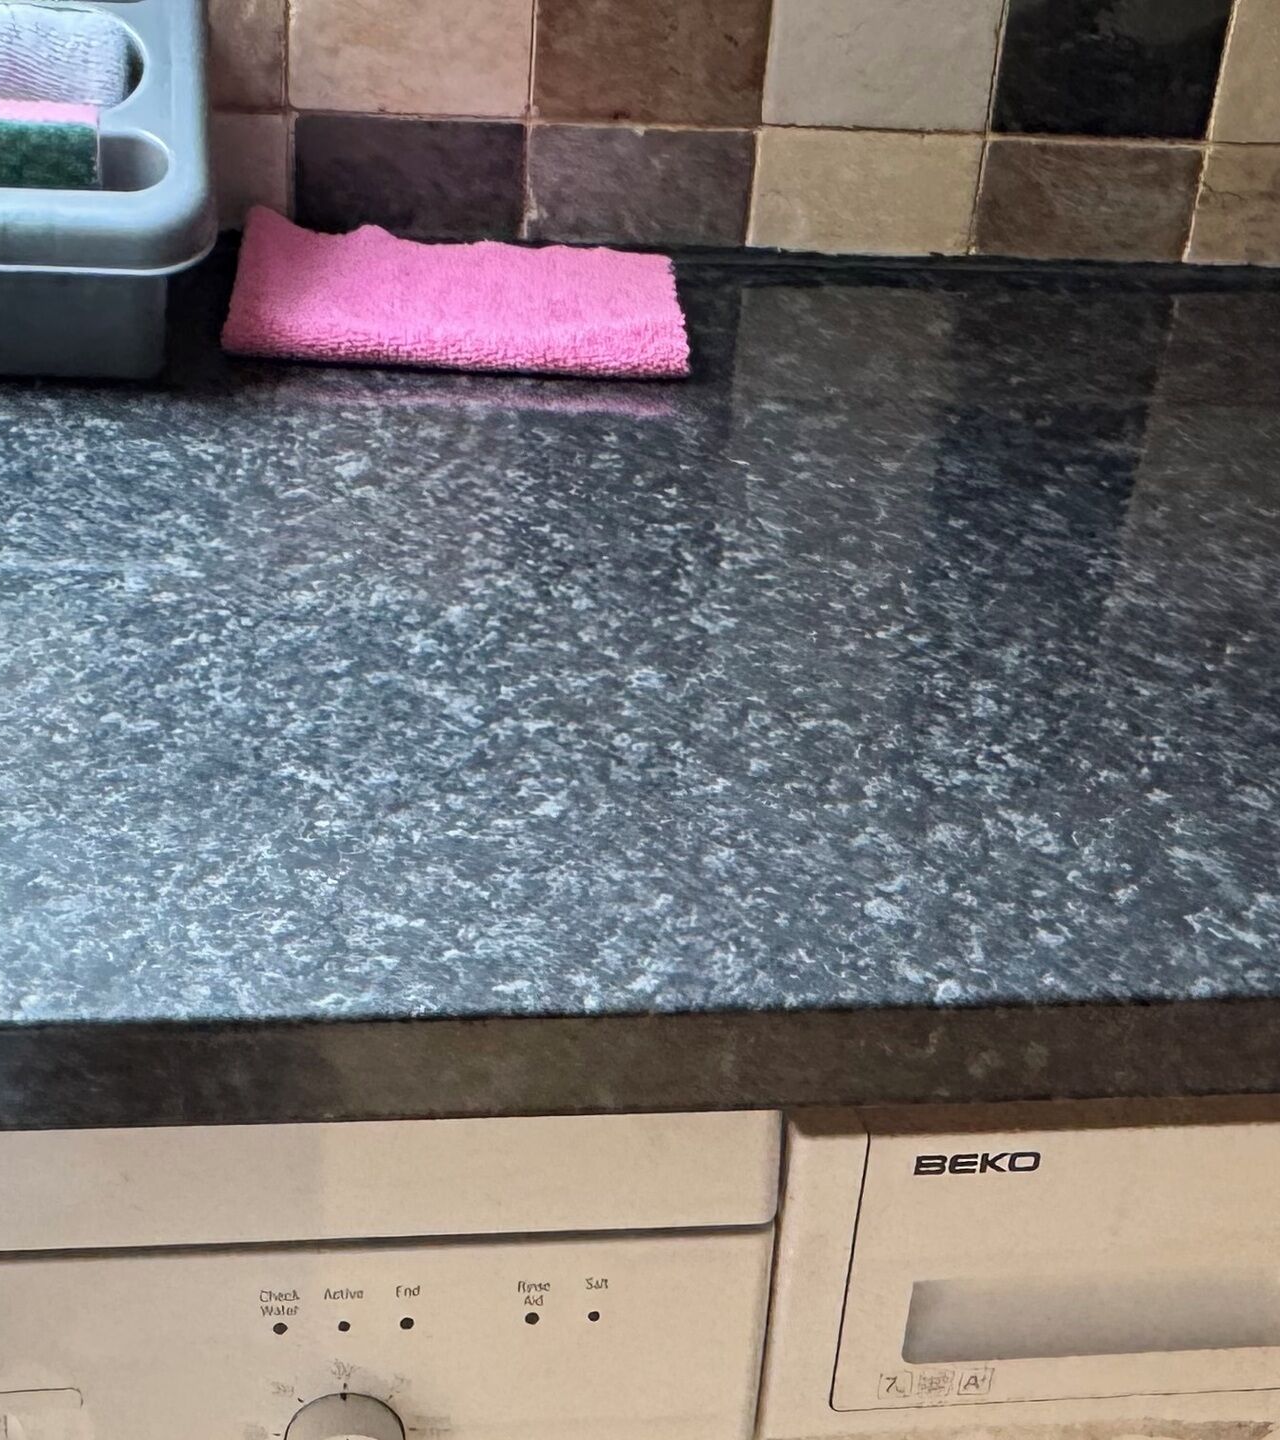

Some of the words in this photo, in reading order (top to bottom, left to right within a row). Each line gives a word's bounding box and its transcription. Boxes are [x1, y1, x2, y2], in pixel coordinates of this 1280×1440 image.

[913, 1151, 1041, 1176] BEKO
[259, 1289, 301, 1303] Check
[323, 1287, 365, 1301] Active
[395, 1285, 421, 1299] End
